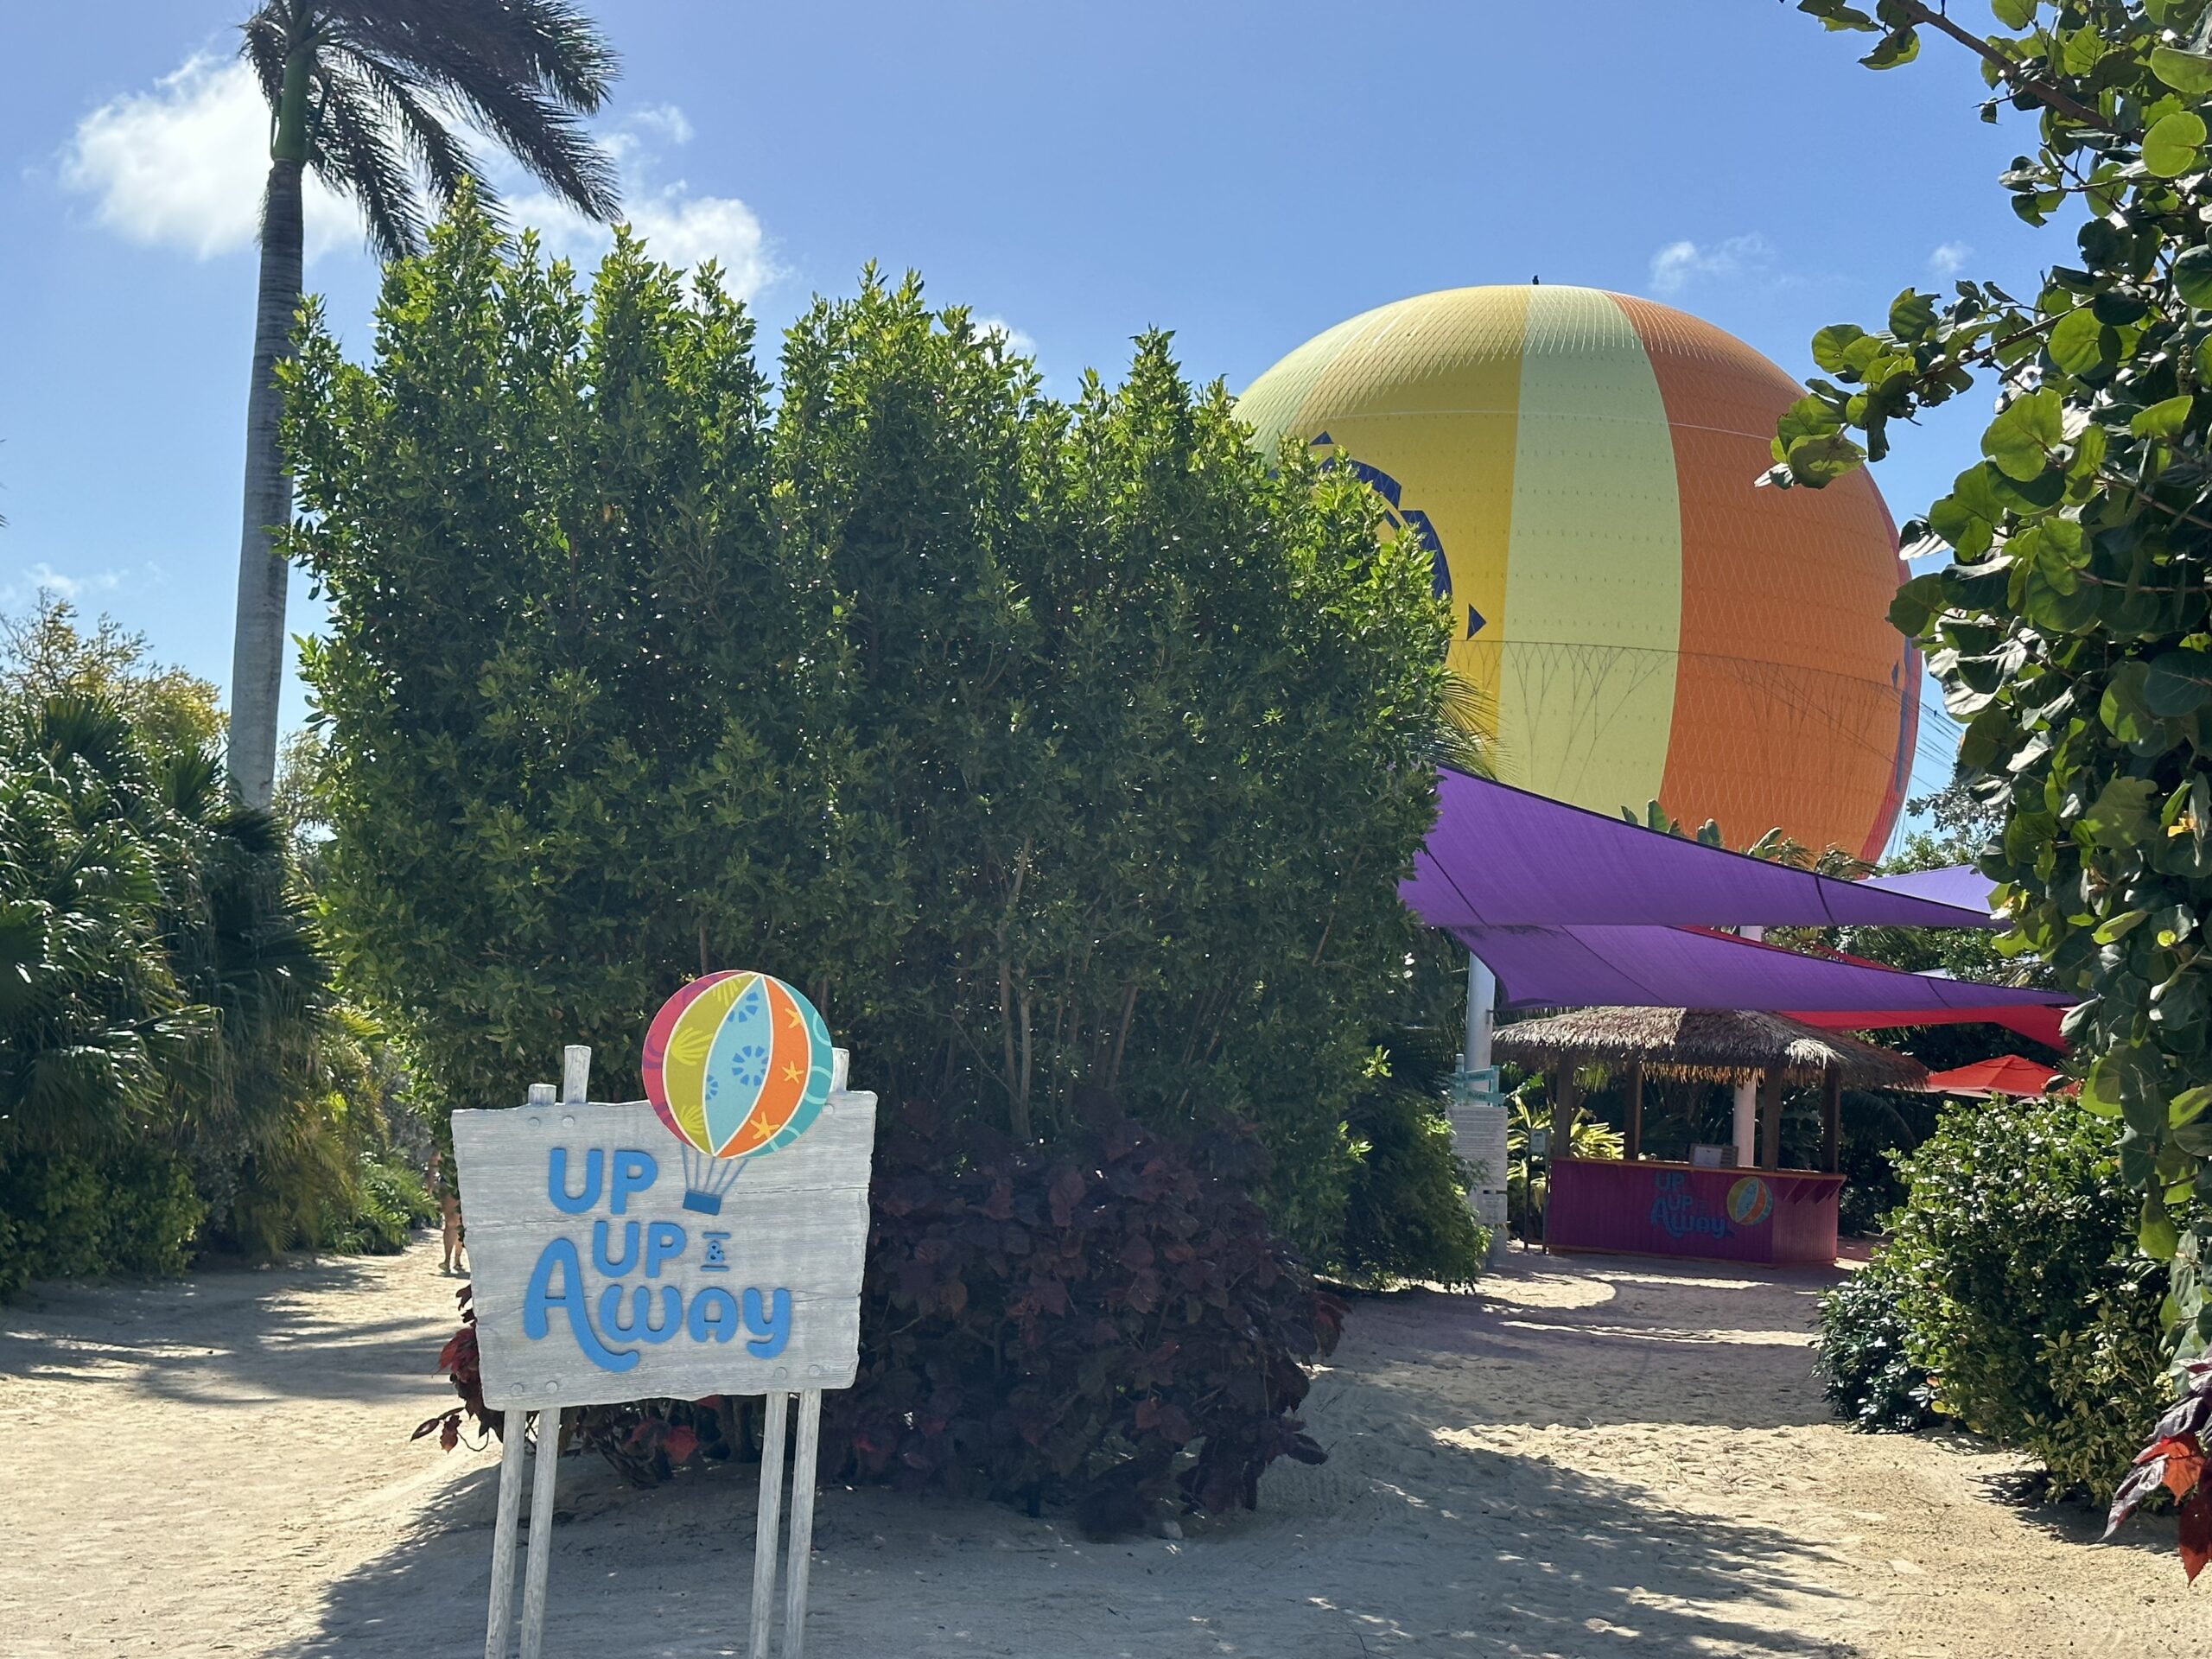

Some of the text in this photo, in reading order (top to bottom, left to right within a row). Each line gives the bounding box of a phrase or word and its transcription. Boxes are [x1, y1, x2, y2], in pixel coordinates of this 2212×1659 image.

[548, 1147, 658, 1215] UP
[1655, 1172, 1685, 1190] UP
[1667, 1194, 1694, 1211] UP
[593, 1220, 686, 1279] UP
